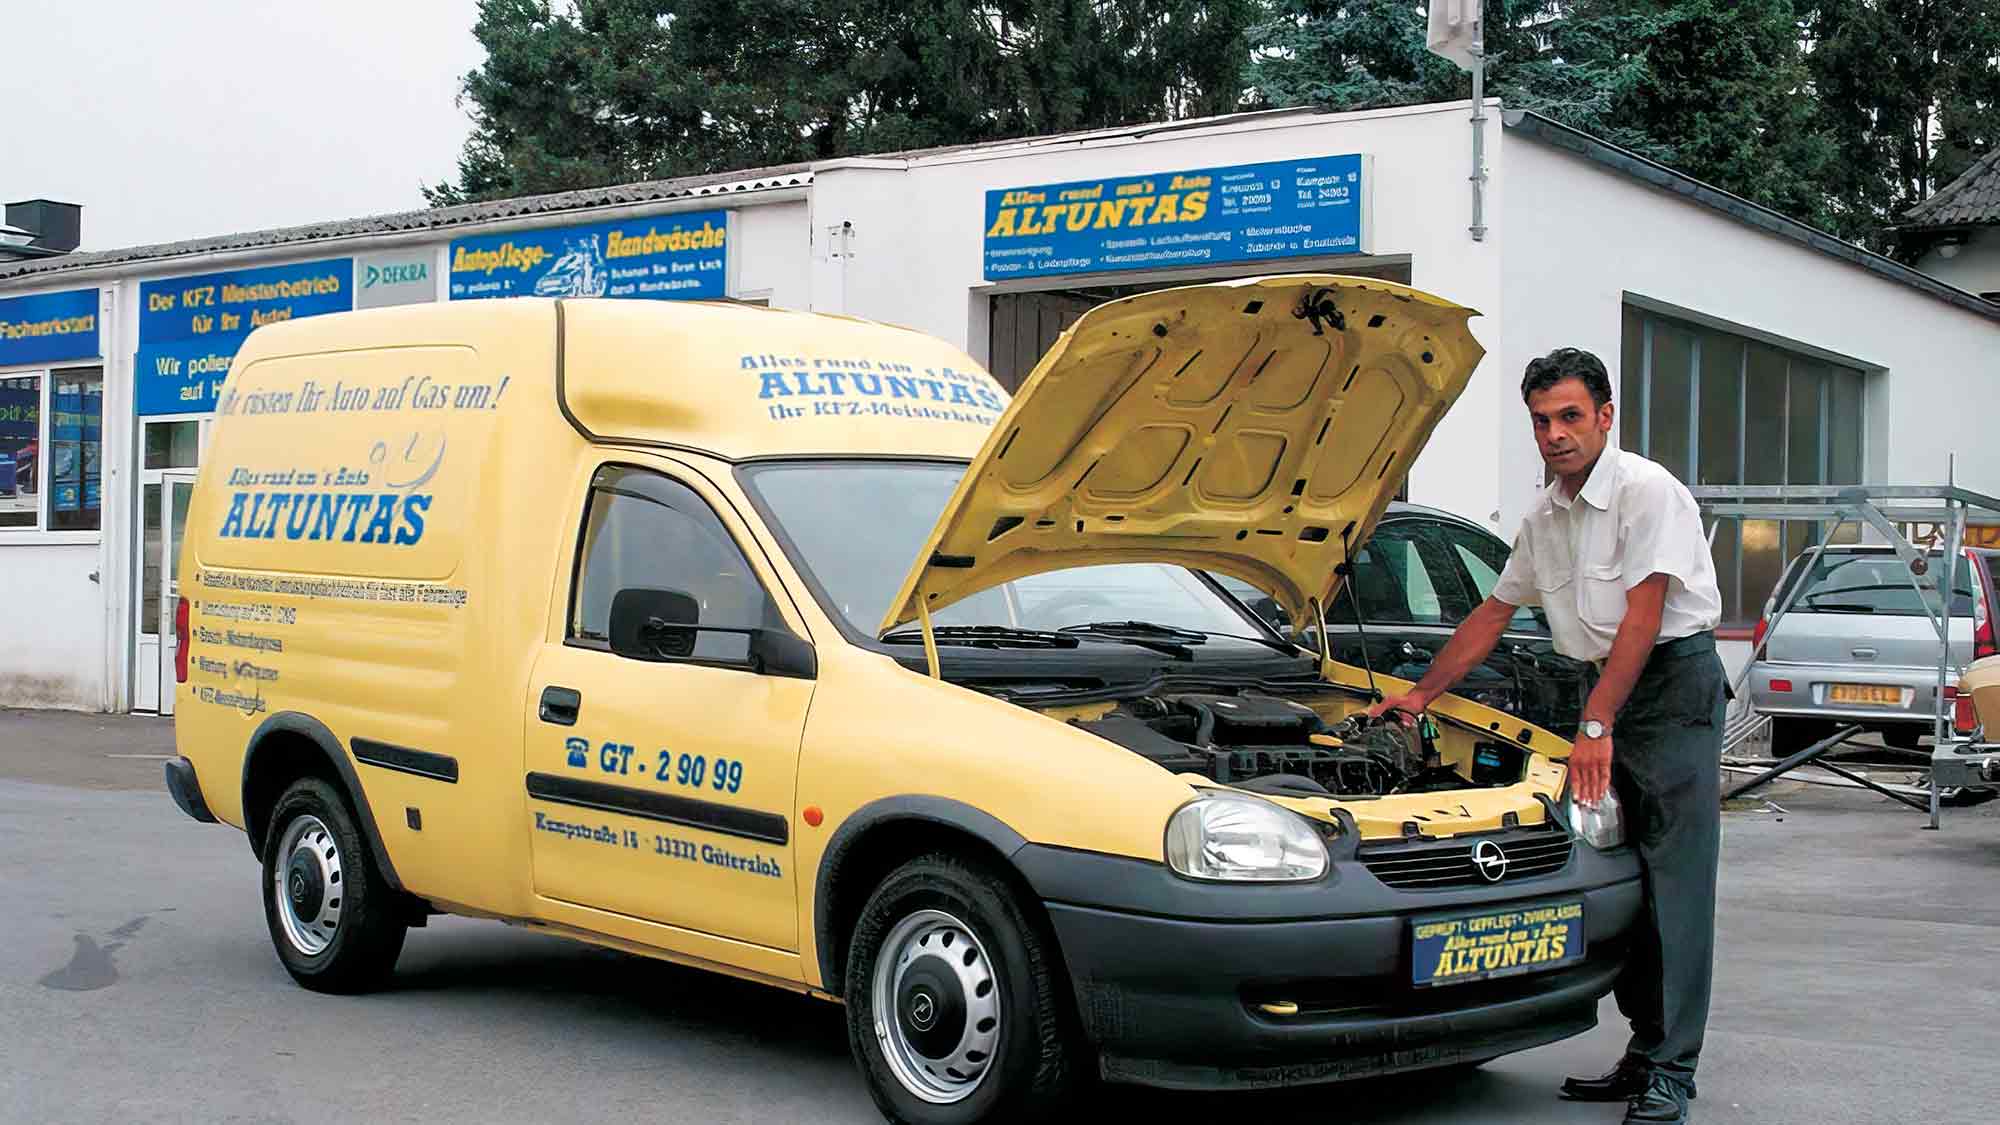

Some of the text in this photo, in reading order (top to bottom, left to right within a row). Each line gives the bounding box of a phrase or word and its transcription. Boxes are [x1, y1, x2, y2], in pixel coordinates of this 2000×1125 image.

[1001, 191, 1046, 206] Alles
[1059, 183, 1104, 201] rund
[1170, 175, 1212, 190] Auto
[986, 191, 1211, 238] ALTUNTAS
[606, 221, 726, 259] Handwäsche
[383, 263, 427, 284] DEKRA
[452, 242, 553, 276] Autopflege-
[149, 275, 340, 311] Der KFZ Meisterbetrieb
[192, 315, 213, 334] für
[221, 313, 240, 330] Ihr
[156, 356, 181, 376] Wir
[740, 354, 807, 370] Alles
[813, 357, 871, 370] rund
[878, 360, 912, 373] um
[941, 367, 990, 388] Auto
[180, 381, 204, 400] auf
[241, 387, 293, 416] rüsten
[296, 380, 325, 414] Ihr
[326, 380, 370, 412] Auto
[372, 375, 415, 410] auf
[412, 375, 451, 410] Gas
[453, 375, 511, 411] um!
[758, 372, 1004, 412] ALTUNTAS
[768, 403, 805, 420] Ihr
[228, 467, 259, 486] Alles
[261, 467, 295, 486] rund
[334, 466, 369, 486] Auto
[220, 492, 433, 546] ALTUNTAS
[656, 750, 671, 782] 2
[677, 752, 706, 788] 90
[712, 758, 743, 794] 99
[535, 812, 618, 845] Kampstraße
[701, 843, 782, 878] Gütersloh
[1444, 936, 1477, 950] Alles
[1479, 930, 1509, 946] rund
[1541, 923, 1568, 937] Auto
[1433, 935, 1567, 977] ALTUNTAS
